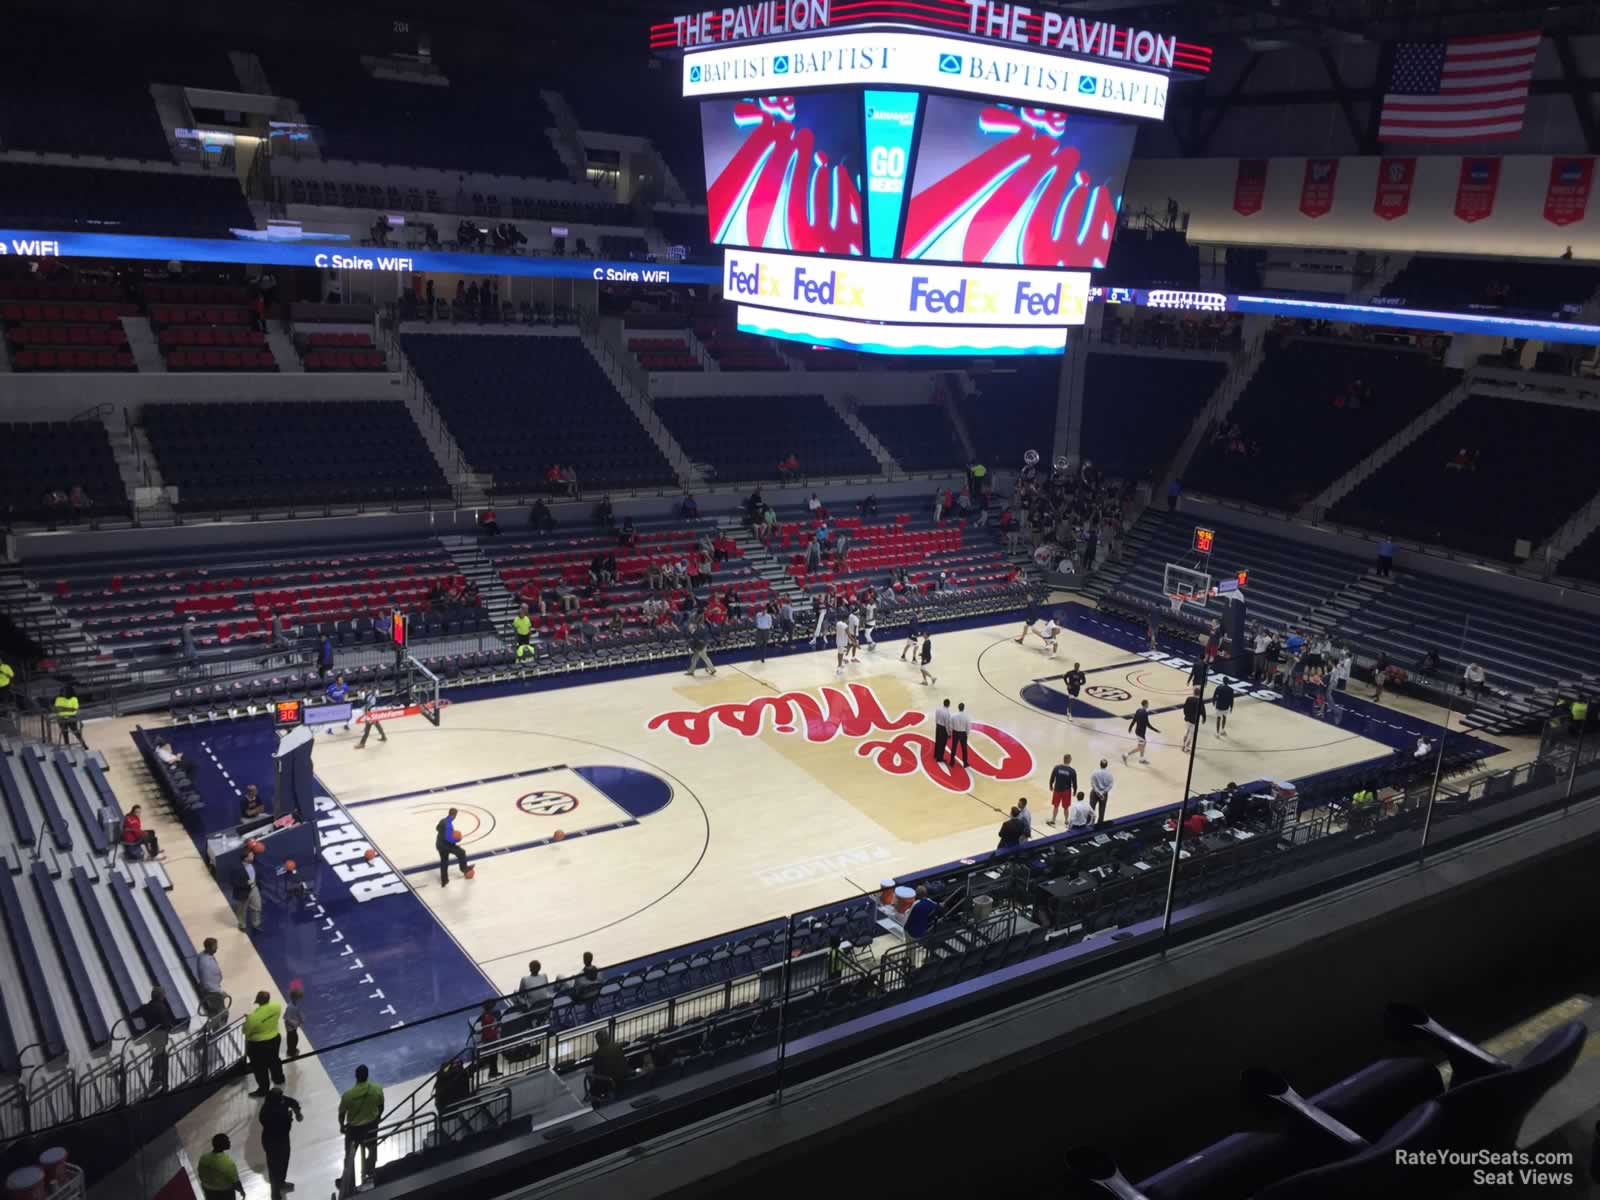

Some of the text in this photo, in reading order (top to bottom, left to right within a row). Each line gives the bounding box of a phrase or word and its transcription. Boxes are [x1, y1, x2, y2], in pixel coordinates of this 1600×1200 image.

[674, 0, 830, 47] THE PAVILION
[965, 0, 1176, 67] THE PAVILION
[704, 56, 768, 82] BAPTIST
[794, 47, 896, 74] BAPTIST
[969, 57, 1071, 92] BAPTIST
[871, 146, 905, 177] GO
[12, 240, 59, 256] WiFi
[315, 253, 328, 268] C
[593, 267, 604, 280] C
[729, 260, 781, 297] FedEx
[794, 267, 865, 308] FedEx
[910, 276, 999, 314] FedEx
[1014, 281, 1084, 316] FedEx
[280, 711, 295, 721] 30
[647, 682, 1033, 792] Ole Miss
